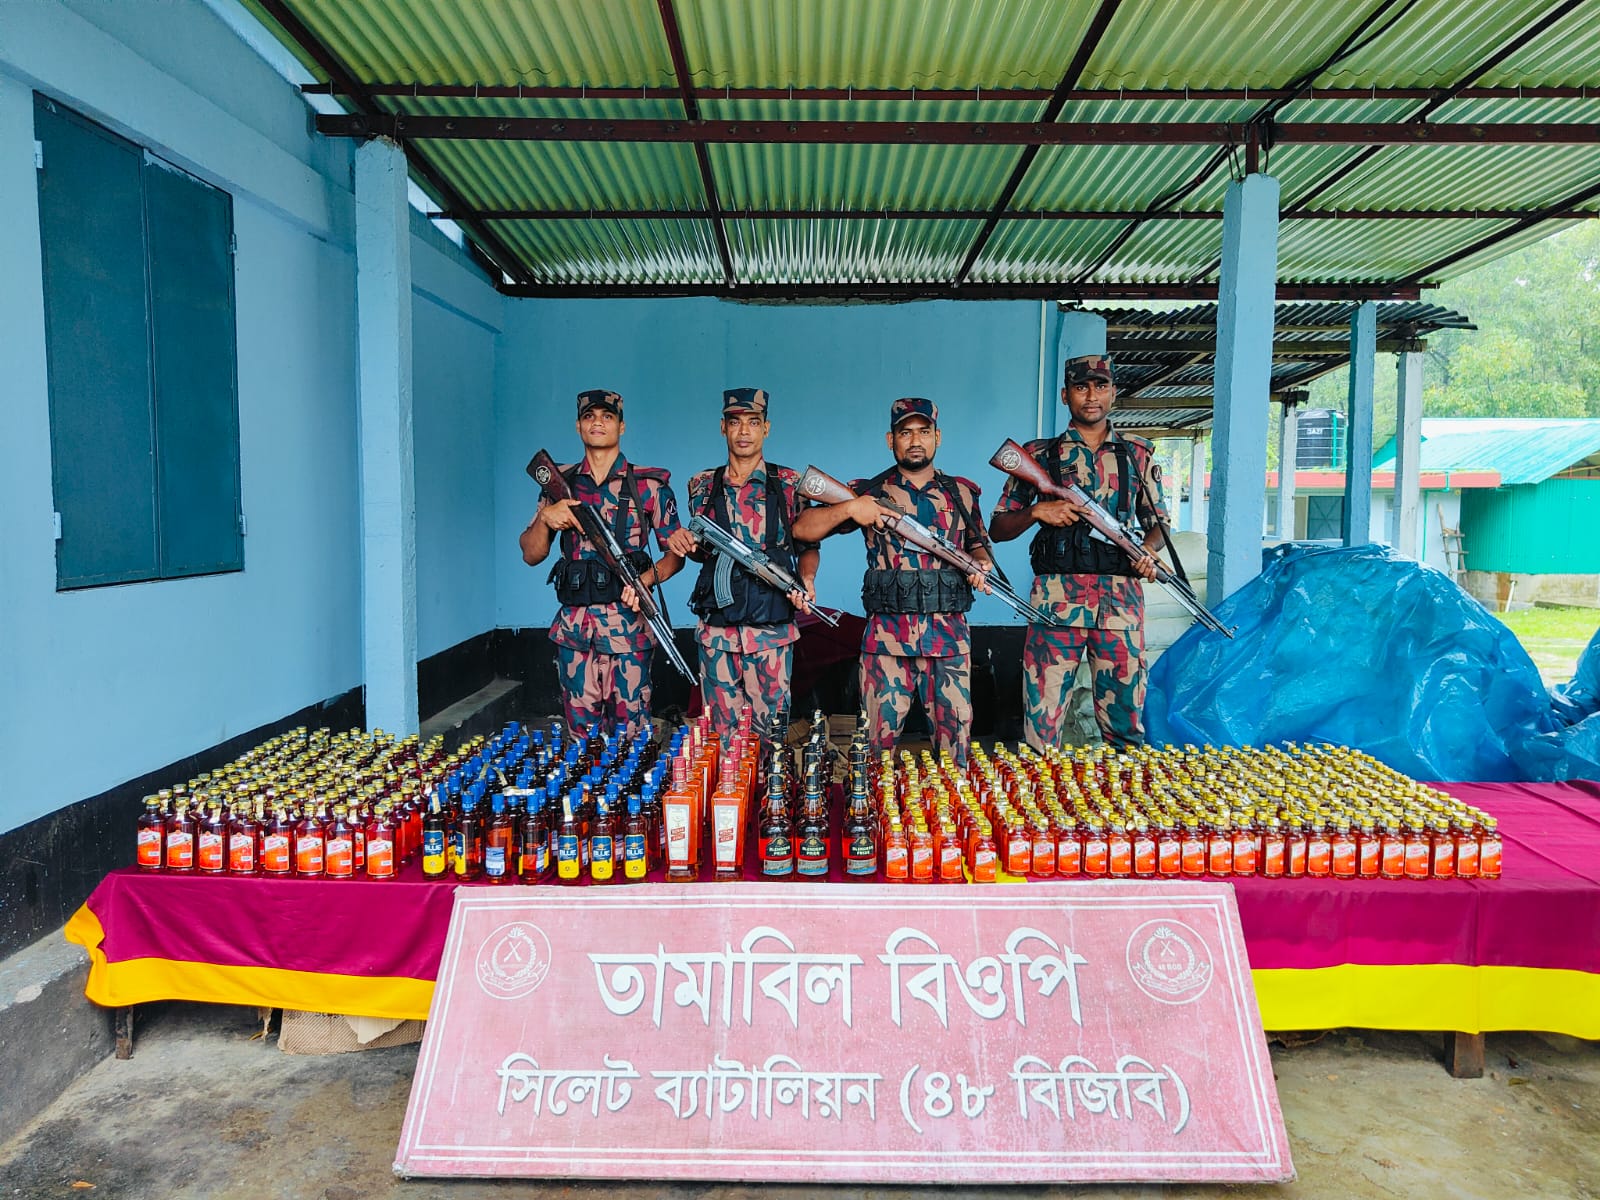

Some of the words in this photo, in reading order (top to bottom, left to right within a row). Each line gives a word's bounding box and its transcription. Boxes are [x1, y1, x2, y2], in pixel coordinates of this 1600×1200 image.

[559, 848, 577, 856] BLUE
[593, 849, 610, 857] BLUE
[587, 926, 864, 1029] তামাবিল
[876, 927, 1088, 1029] বিওপি
[496, 1052, 640, 1117] সিলেট
[650, 1053, 883, 1120] ব্যাটালিয়ন
[900, 1063, 994, 1134] (৪৮
[1008, 1055, 1190, 1134] বিজিবি)
